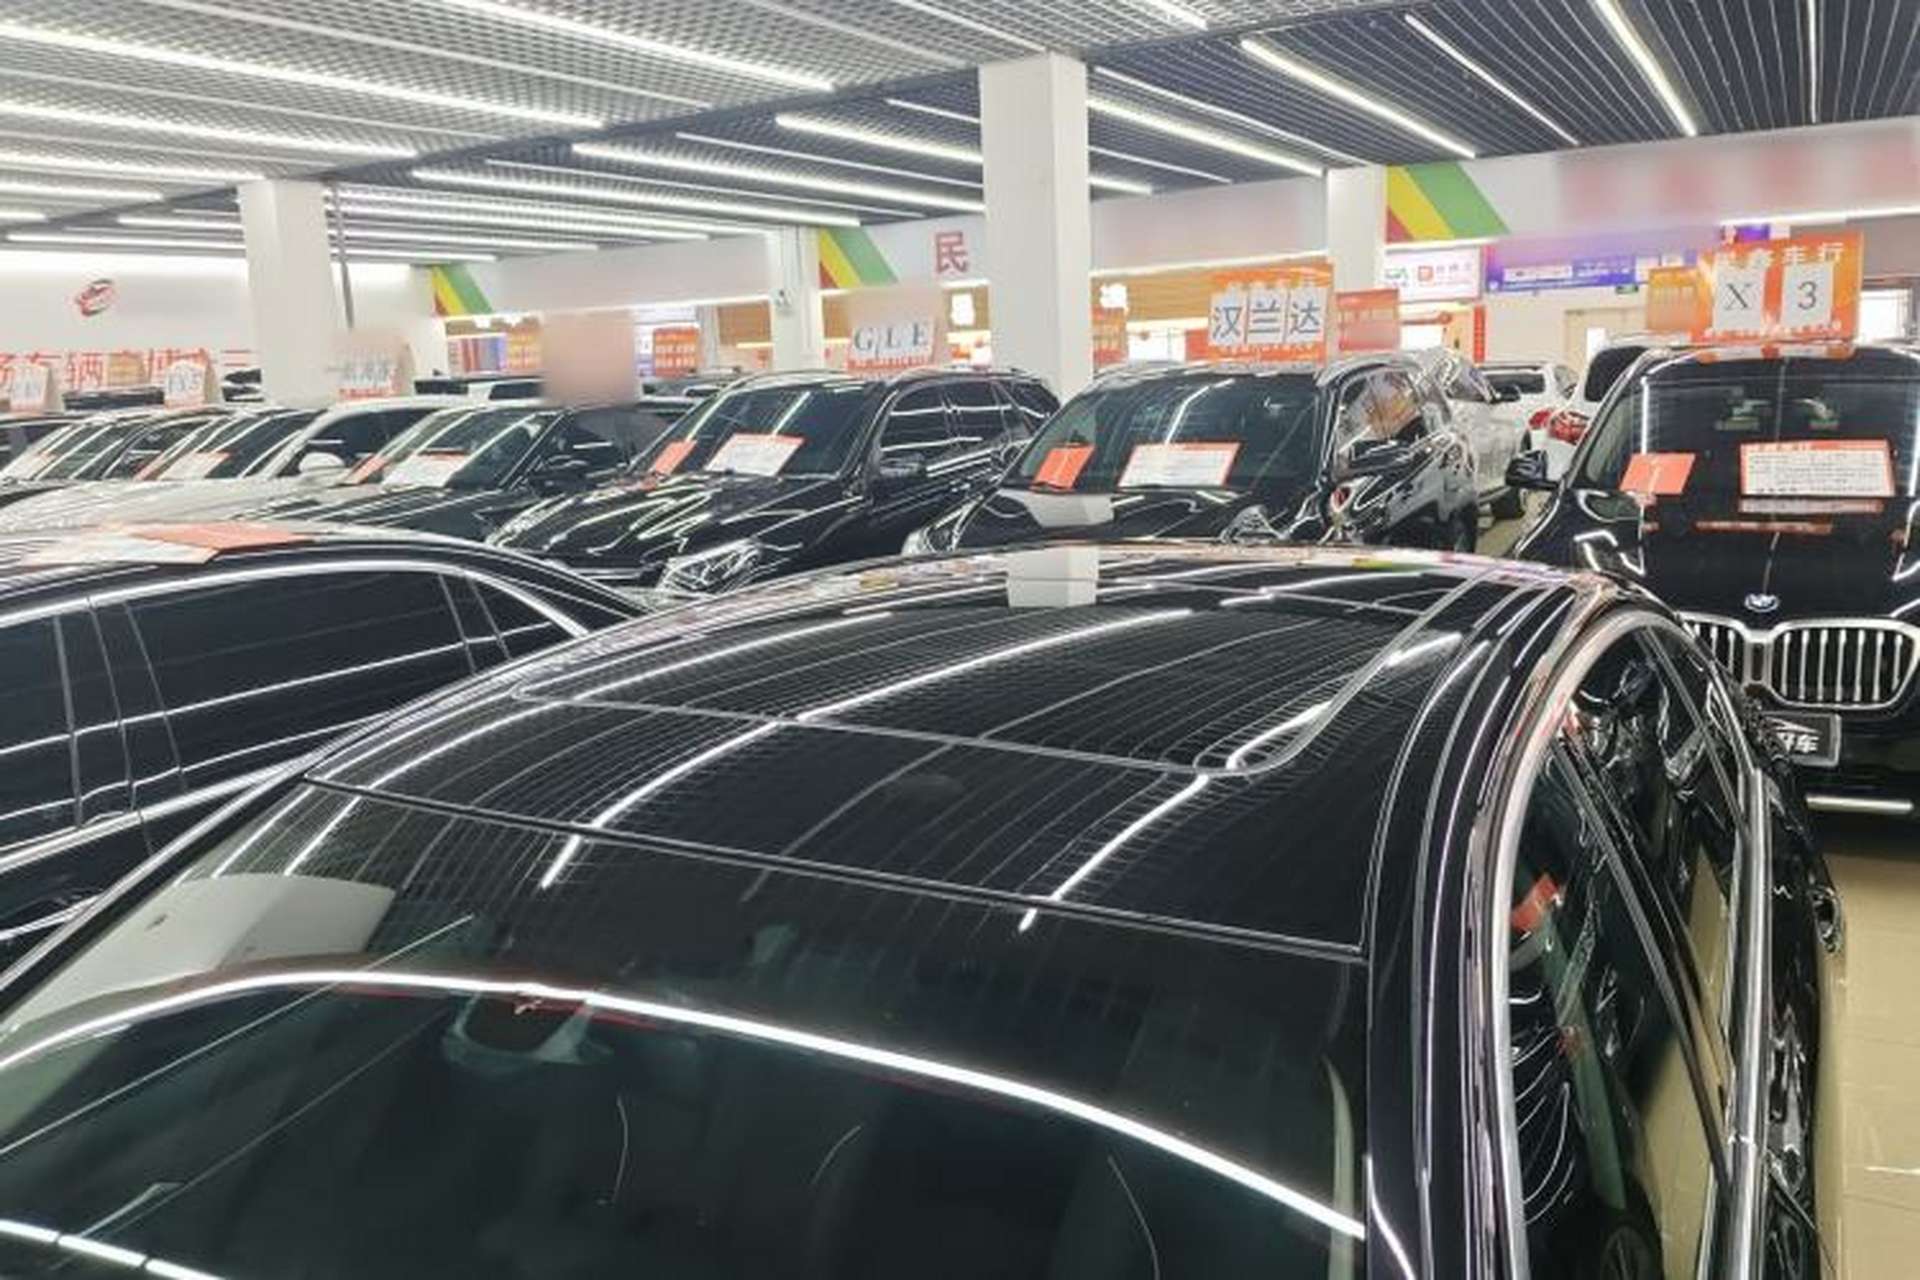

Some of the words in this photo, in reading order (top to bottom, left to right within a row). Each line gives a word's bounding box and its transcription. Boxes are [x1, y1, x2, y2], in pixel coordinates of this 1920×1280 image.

[935, 230, 968, 274] 民
[1211, 299, 1321, 340] 汉兰达
